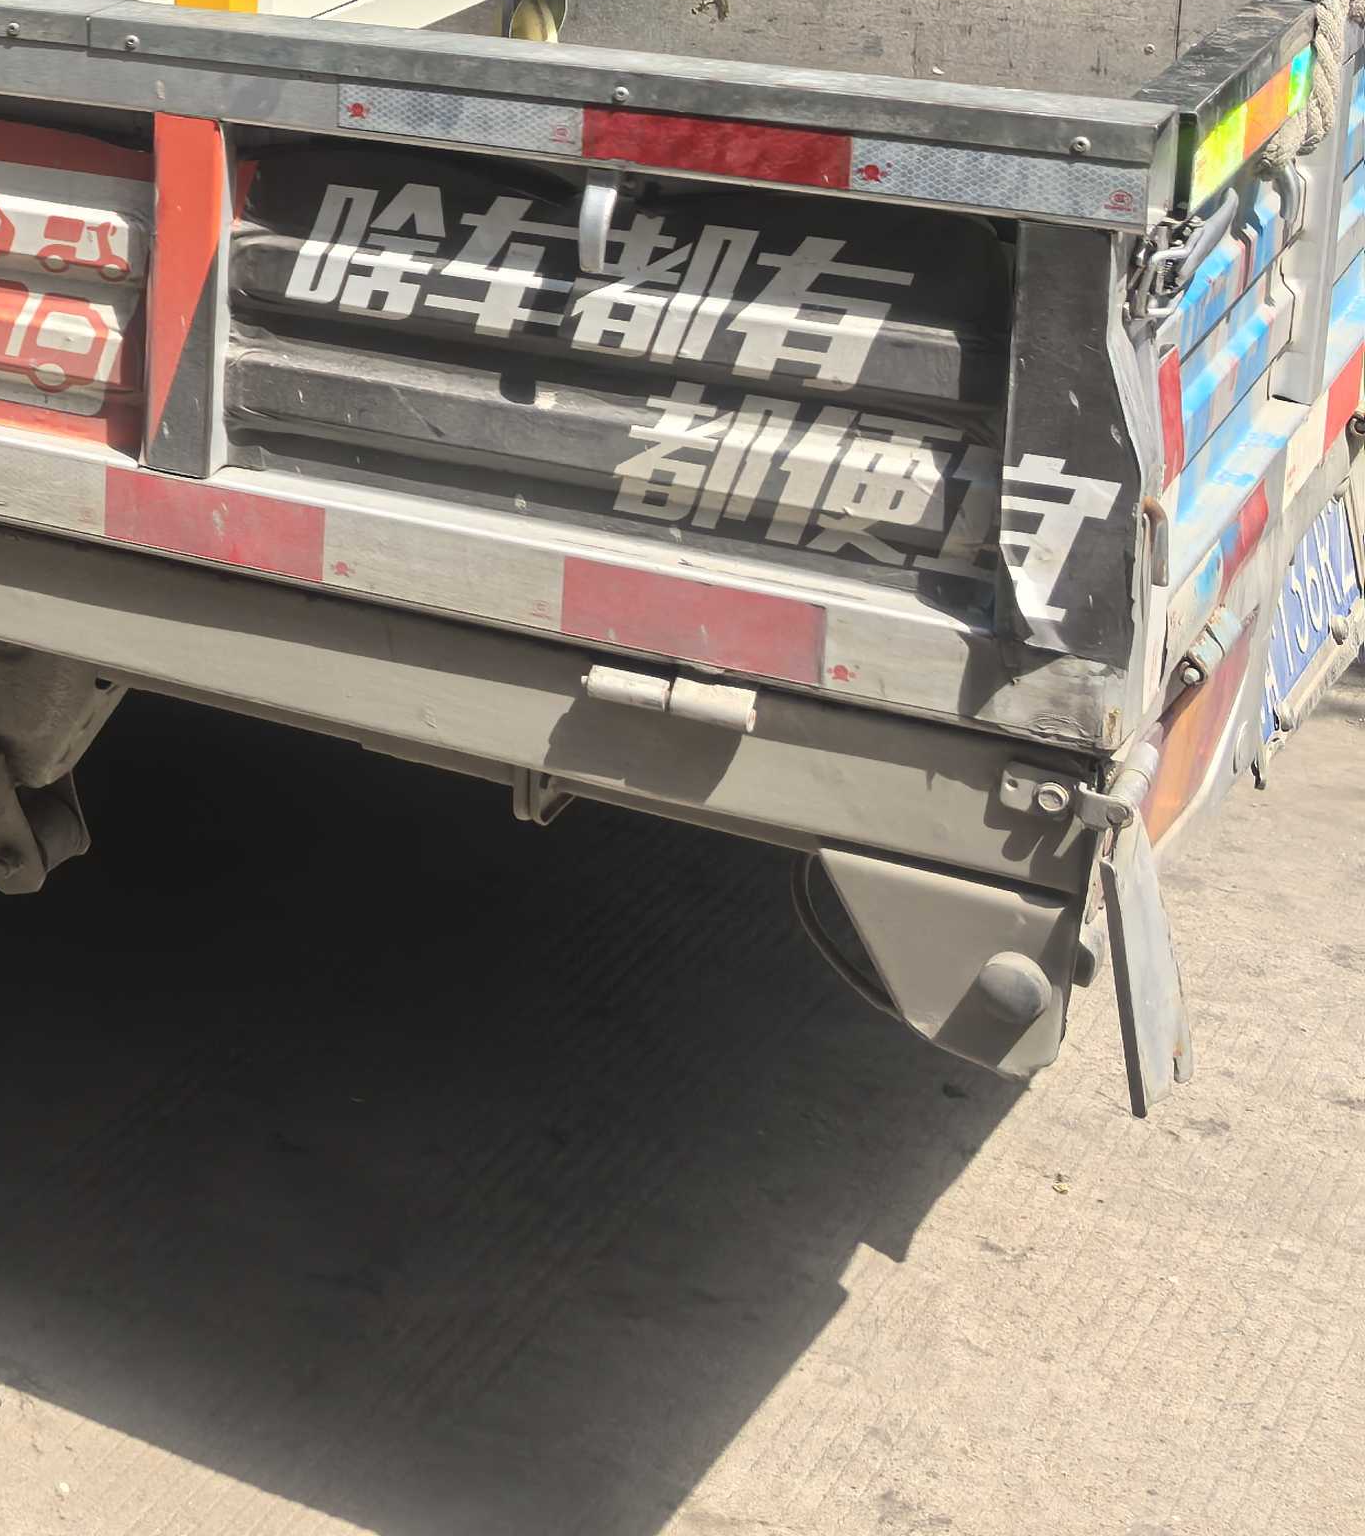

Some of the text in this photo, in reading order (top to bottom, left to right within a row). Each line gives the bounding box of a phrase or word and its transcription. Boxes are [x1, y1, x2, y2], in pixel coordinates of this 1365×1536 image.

[285, 182, 914, 390] 啥车都有
[612, 381, 1123, 623] 都便宜
